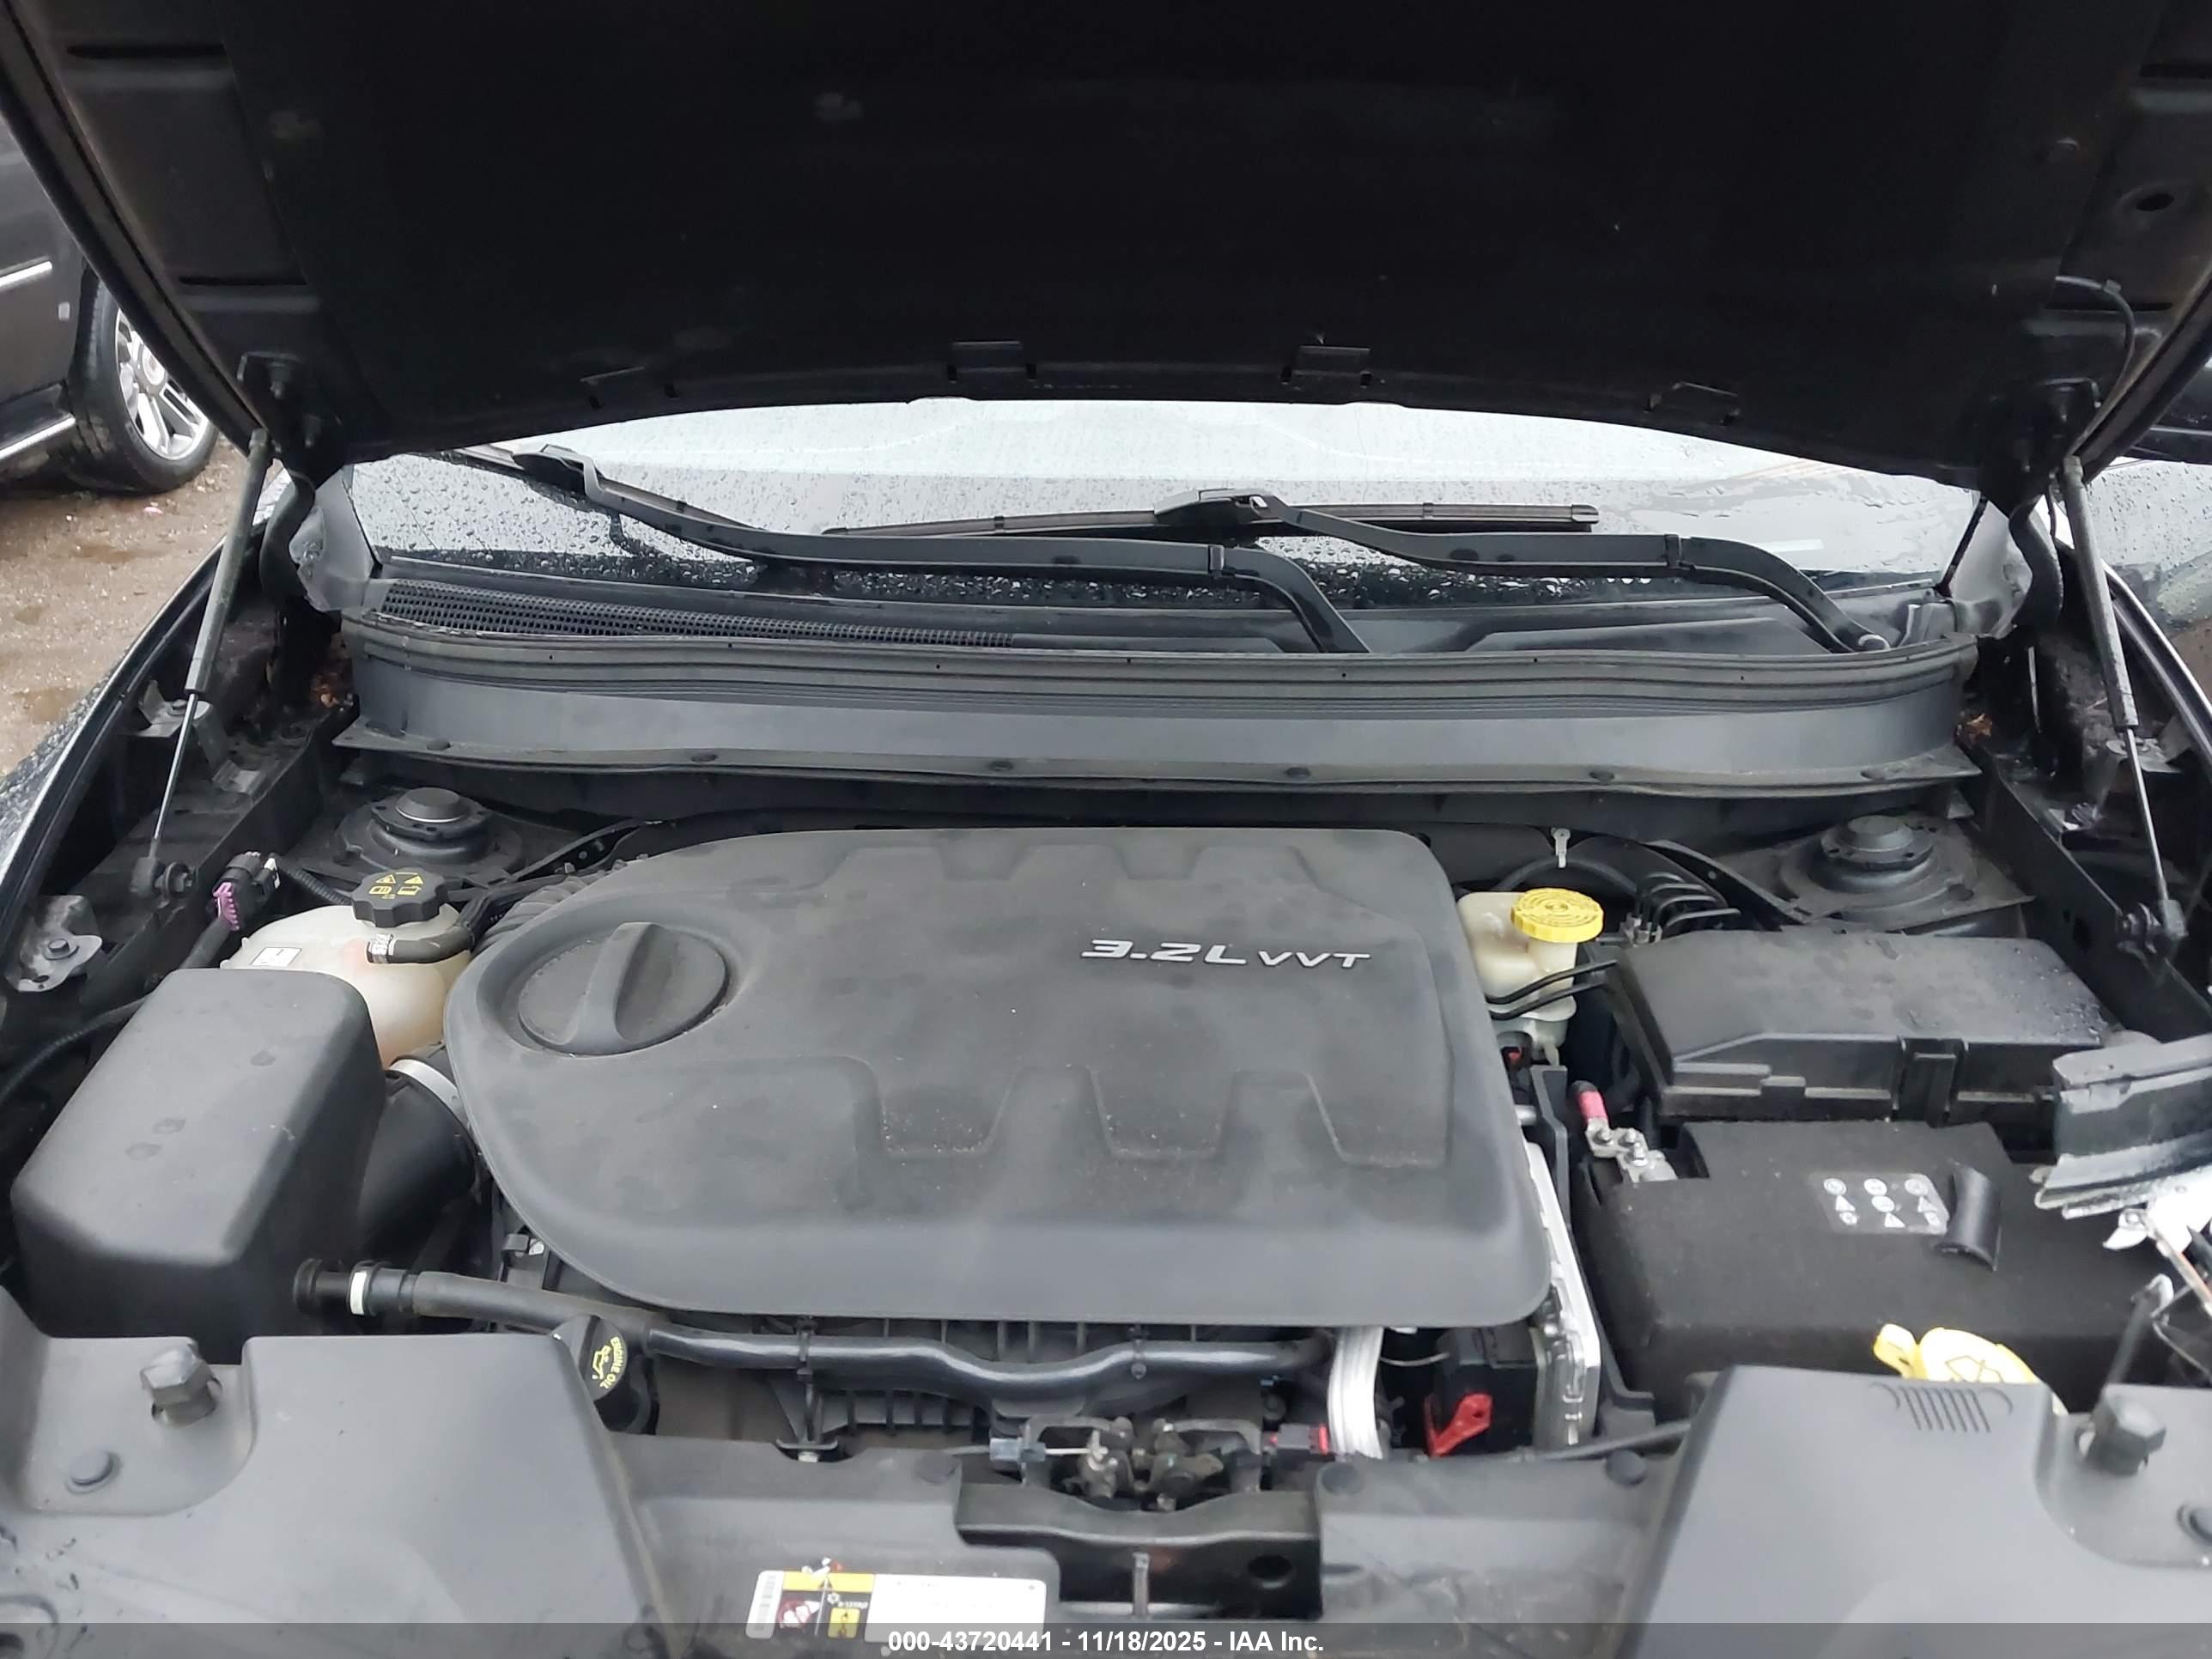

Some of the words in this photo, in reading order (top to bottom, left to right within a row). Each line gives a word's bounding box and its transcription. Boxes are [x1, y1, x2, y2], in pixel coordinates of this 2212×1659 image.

[1081, 939, 1247, 964] 3.2L
[1258, 951, 1371, 968] VVT
[611, 1337, 623, 1373] ENGINE
[600, 1374, 616, 1389] OIL
